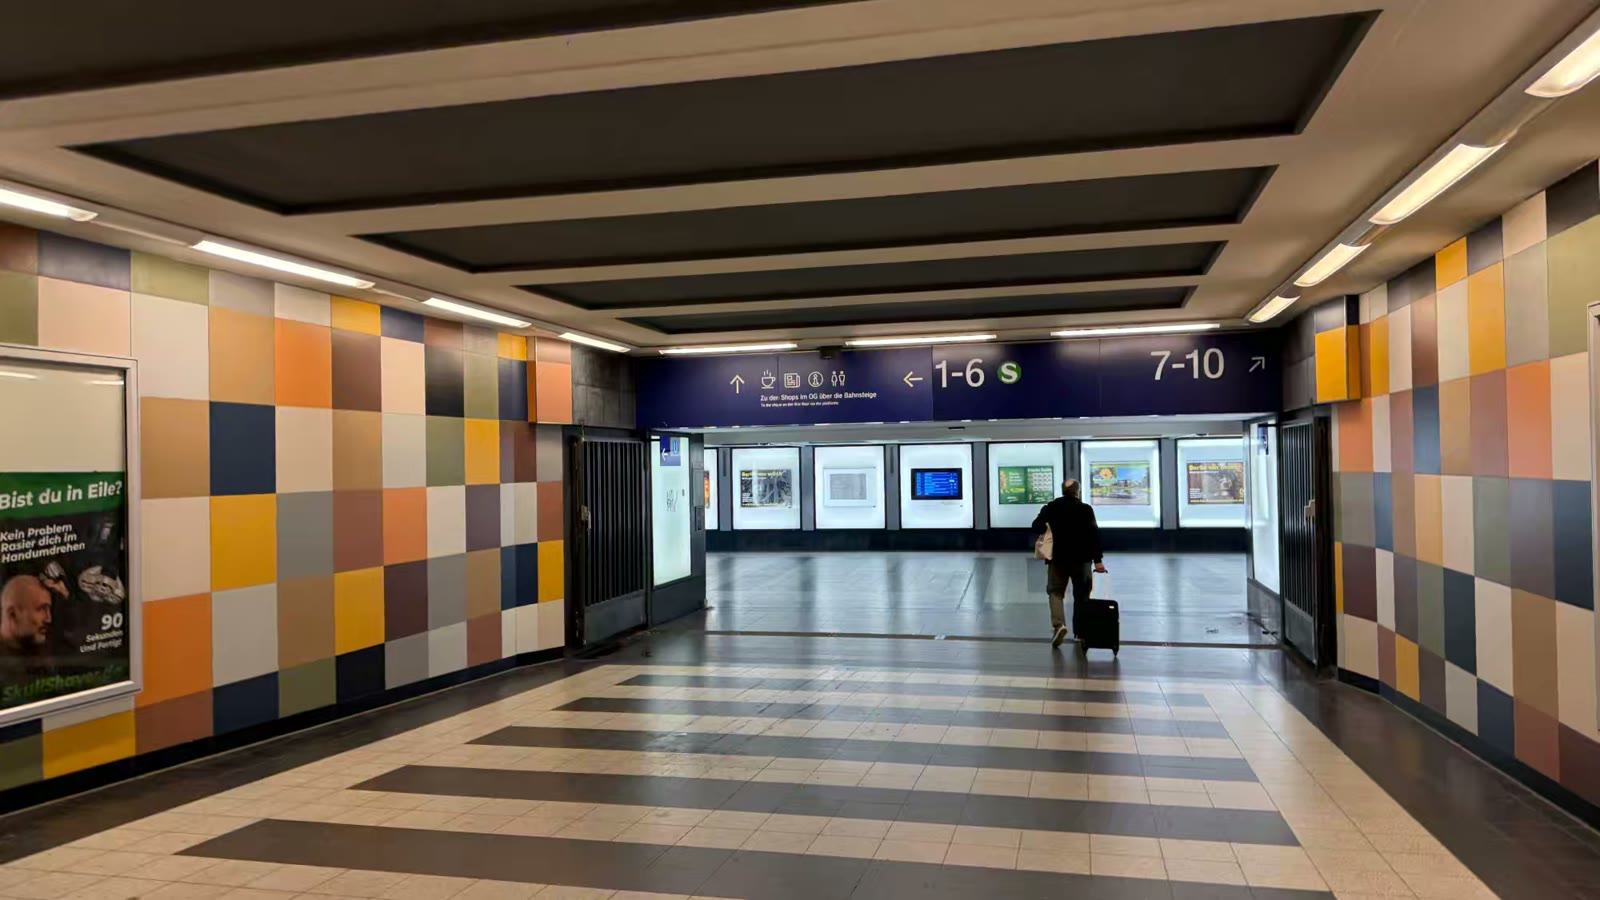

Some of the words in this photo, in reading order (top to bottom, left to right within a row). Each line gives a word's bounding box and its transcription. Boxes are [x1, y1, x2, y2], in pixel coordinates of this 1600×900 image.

[935, 358, 985, 389] 1-6
[1000, 362, 1019, 384] S
[1150, 348, 1225, 381] 7-10
[760, 394, 769, 402] Zu
[780, 394, 799, 402] Shops
[808, 392, 818, 400] OG
[819, 391, 833, 400] über
[833, 391, 843, 399] die
[844, 390, 877, 400] Bahnsteige
[0, 492, 34, 510] Bist
[39, 487, 62, 505] du
[67, 484, 83, 502] in
[87, 480, 123, 499] Eile?
[0, 528, 25, 542] Kein
[28, 523, 73, 538] Problem
[1, 538, 36, 553] Rasier
[38, 534, 61, 547] dich
[63, 532, 78, 543] im
[1, 542, 86, 564] Handumdrehen
[101, 612, 124, 631] 90
[86, 629, 124, 643] Sekunden
